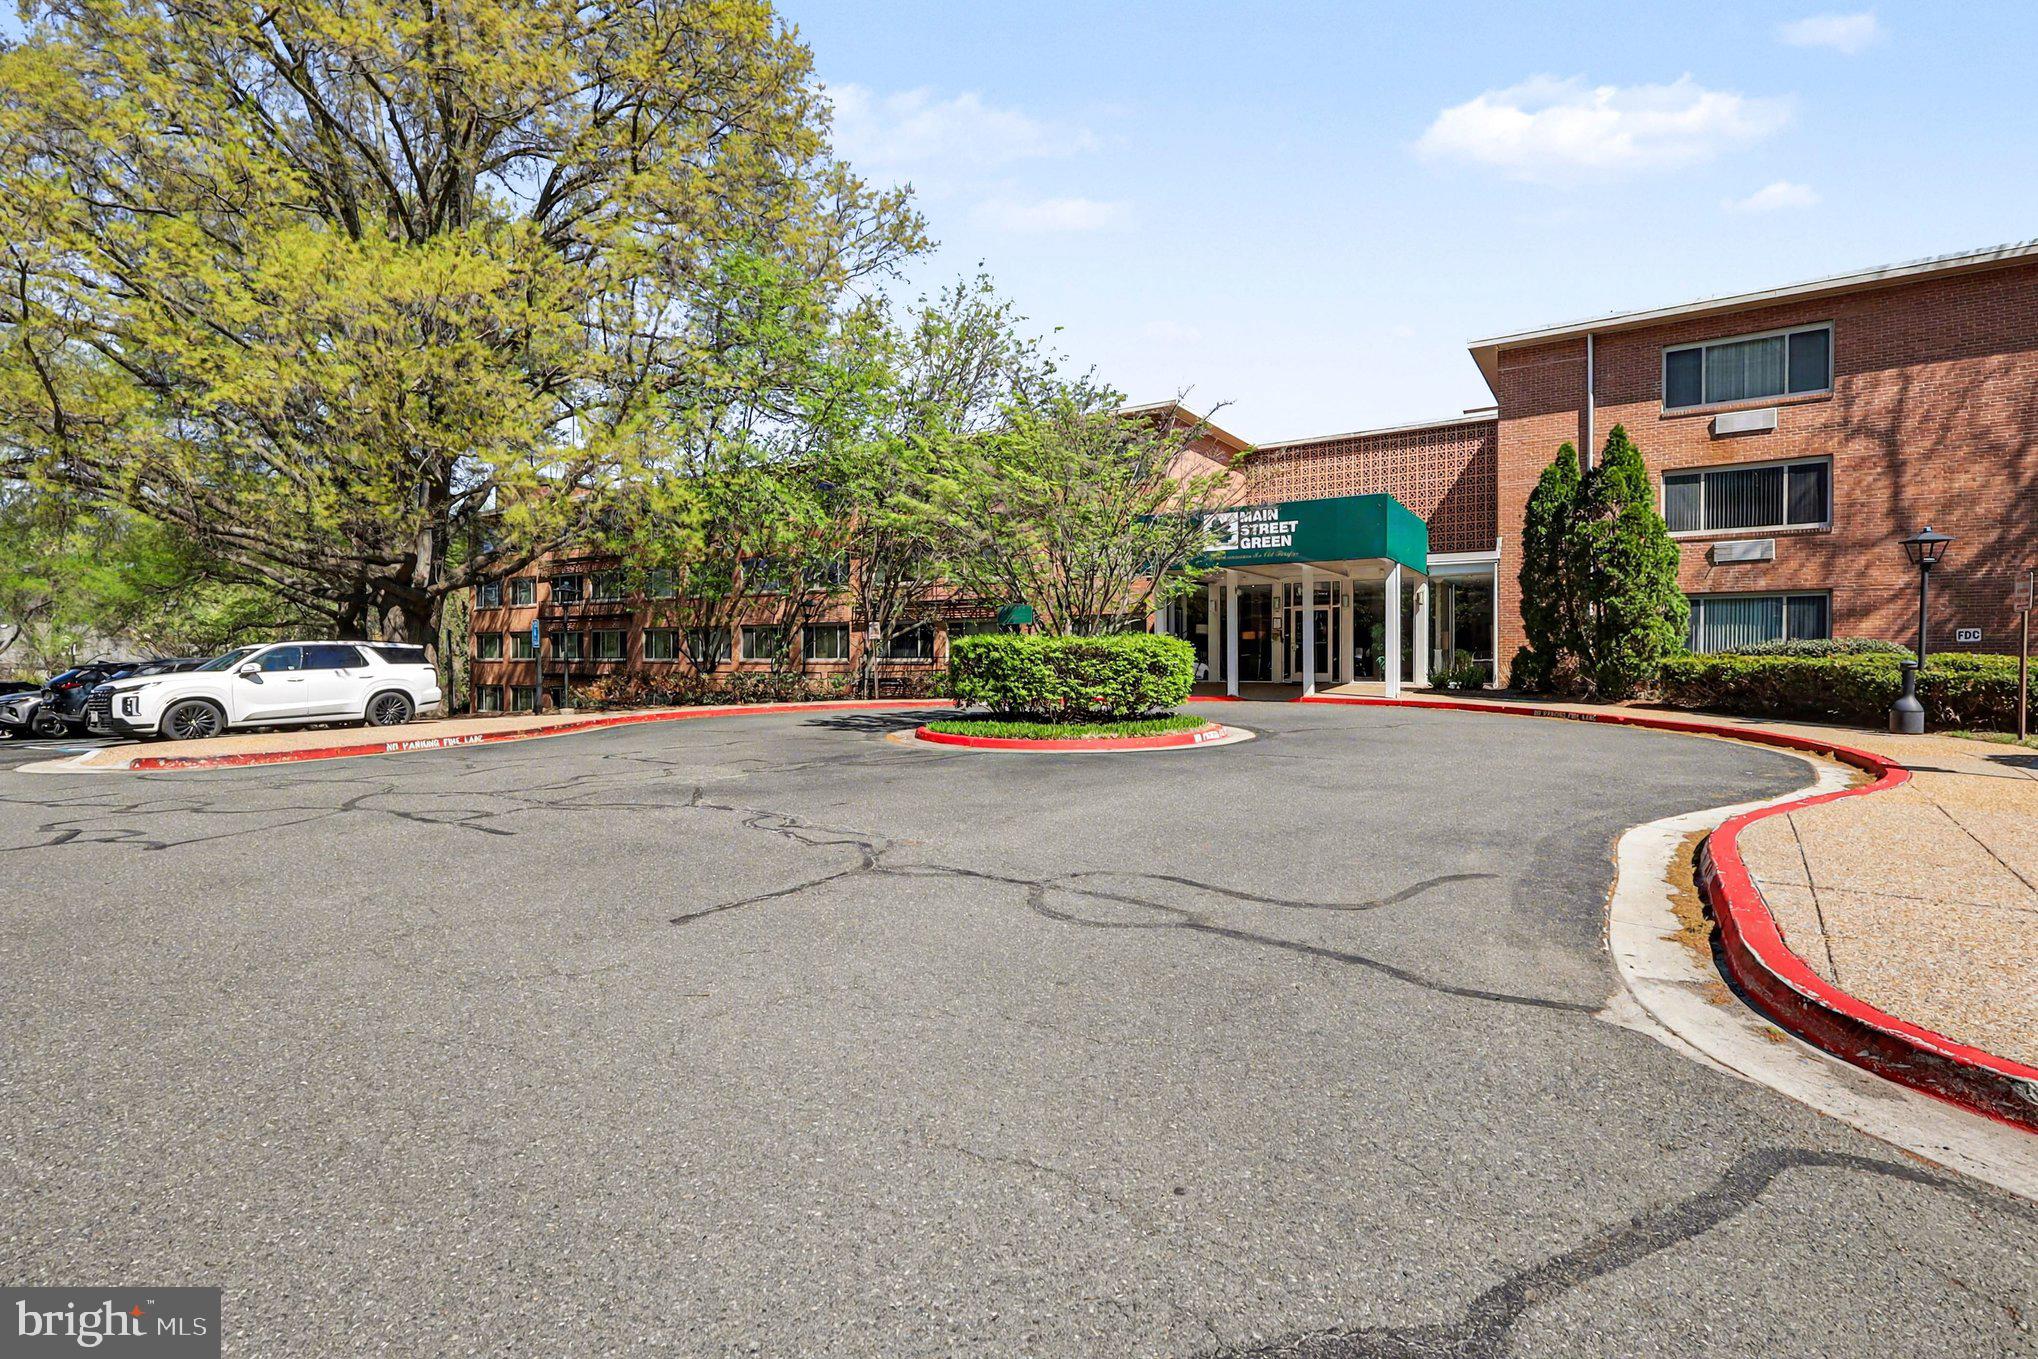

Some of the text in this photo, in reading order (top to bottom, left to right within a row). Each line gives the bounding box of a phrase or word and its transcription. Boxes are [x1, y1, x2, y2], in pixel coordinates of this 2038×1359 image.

[1240, 508, 1279, 522] MAIN
[1240, 520, 1299, 536] STREET
[1240, 534, 1292, 549] GREEN
[1957, 630, 1980, 640] FDC
